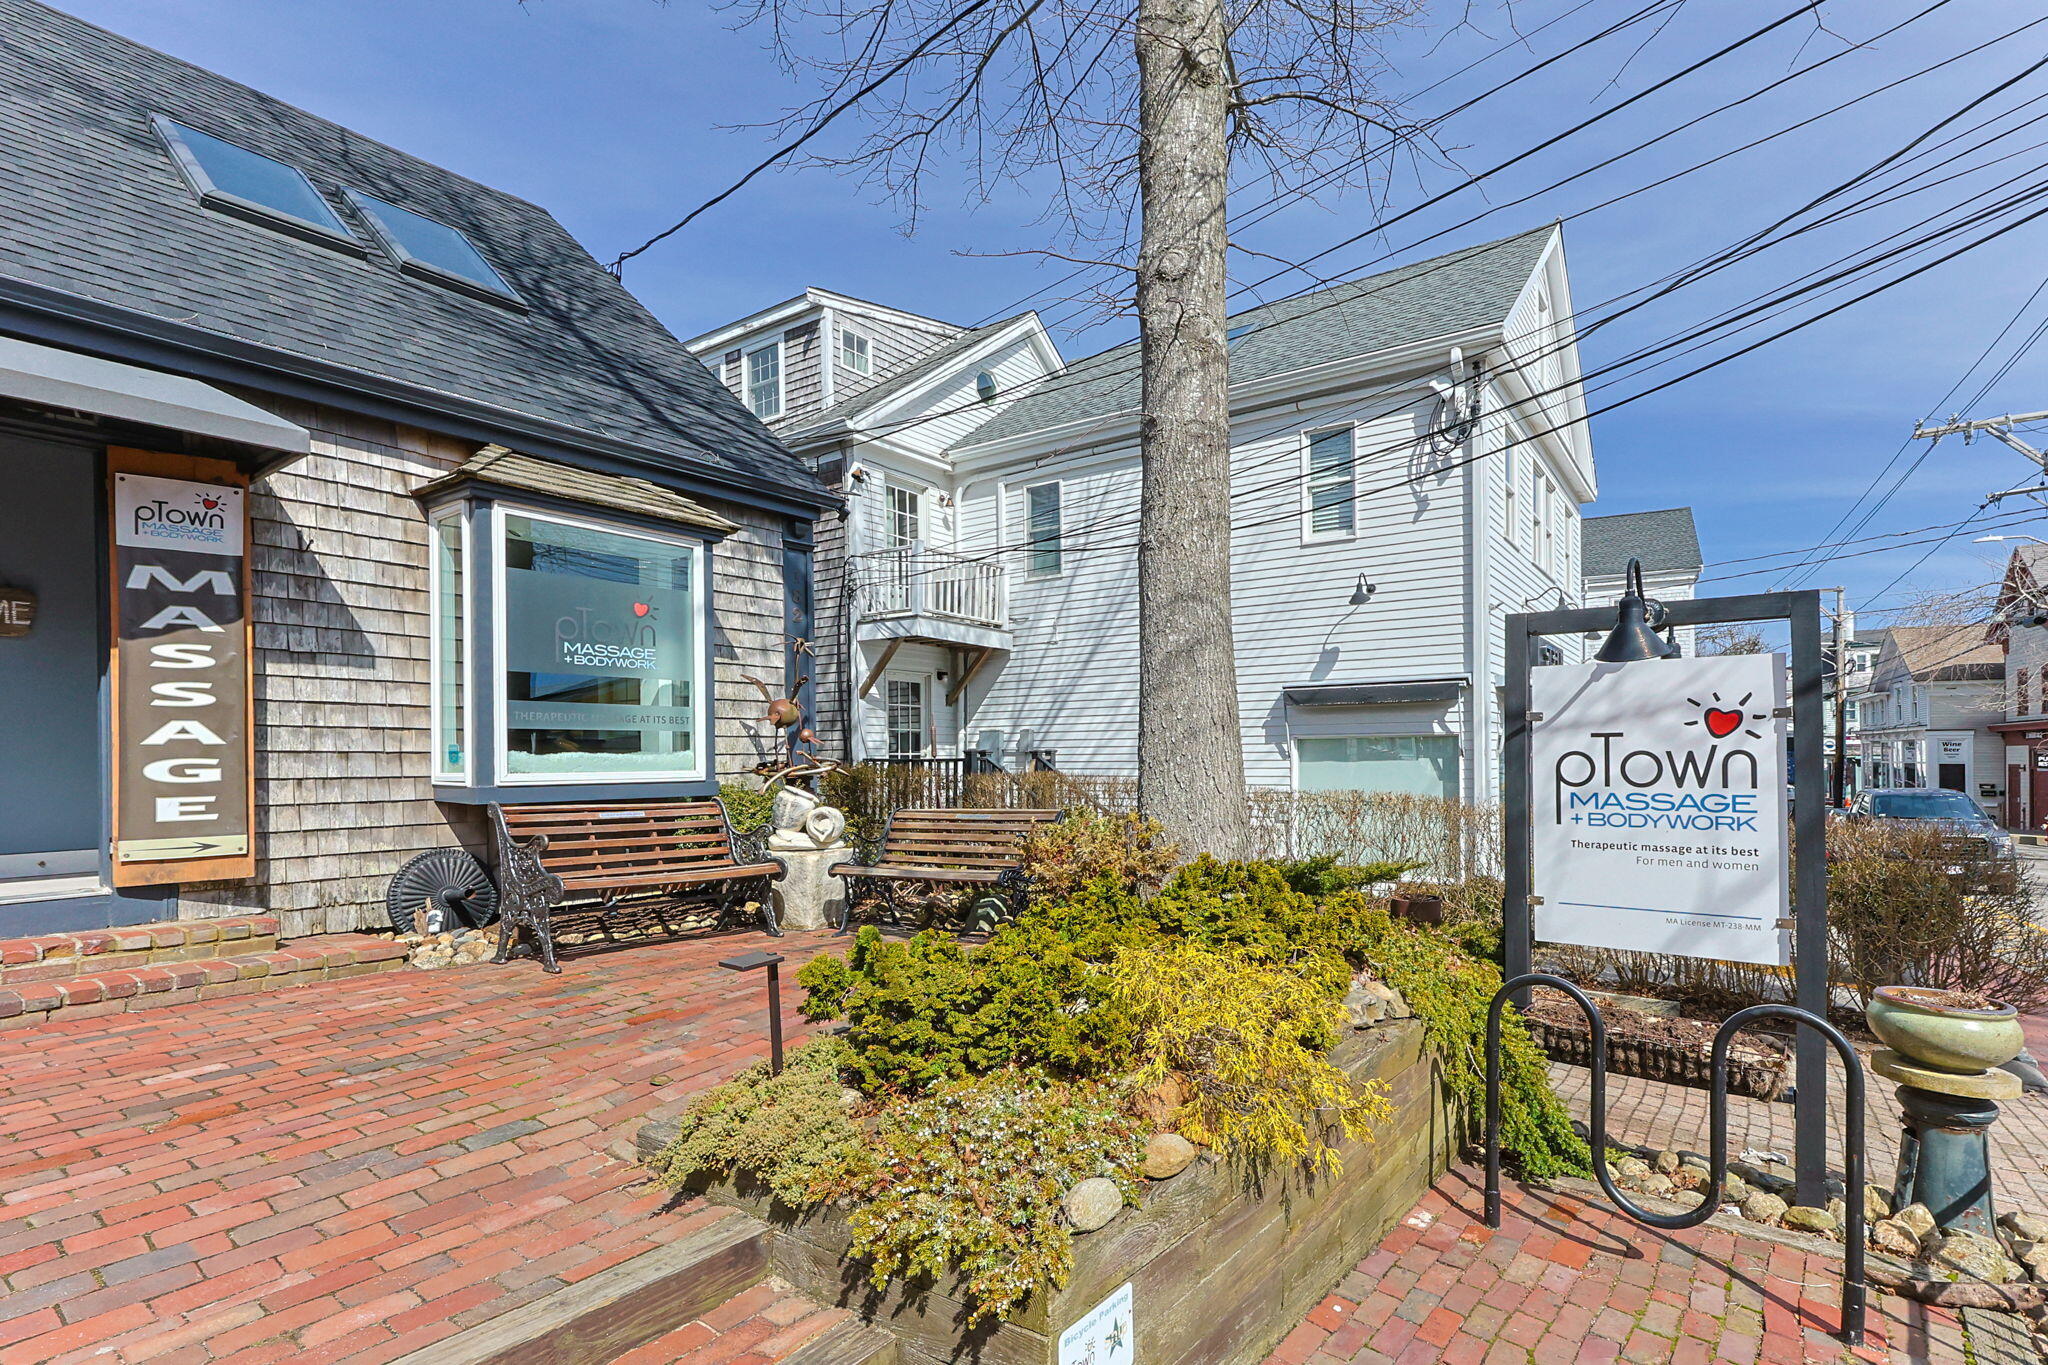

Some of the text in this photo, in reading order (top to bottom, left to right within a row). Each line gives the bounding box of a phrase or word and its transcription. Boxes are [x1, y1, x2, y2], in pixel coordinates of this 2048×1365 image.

[141, 521, 224, 537] MASSAGE
[563, 641, 657, 660] MASSAGE
[125, 564, 236, 823] MASSAGE
[639, 715, 651, 724] AT
[653, 715, 667, 725] ITS
[669, 716, 691, 725] BEST
[1555, 732, 1758, 825] pTown
[1570, 792, 1758, 814] MASSAGE
[1571, 839, 1760, 857] Therapeutic massage at its best
[1636, 856, 1760, 871] For men and women
[1665, 917, 1762, 931] MA License MT-238-MM
[1064, 1292, 1129, 1348] Bicycle Parking
